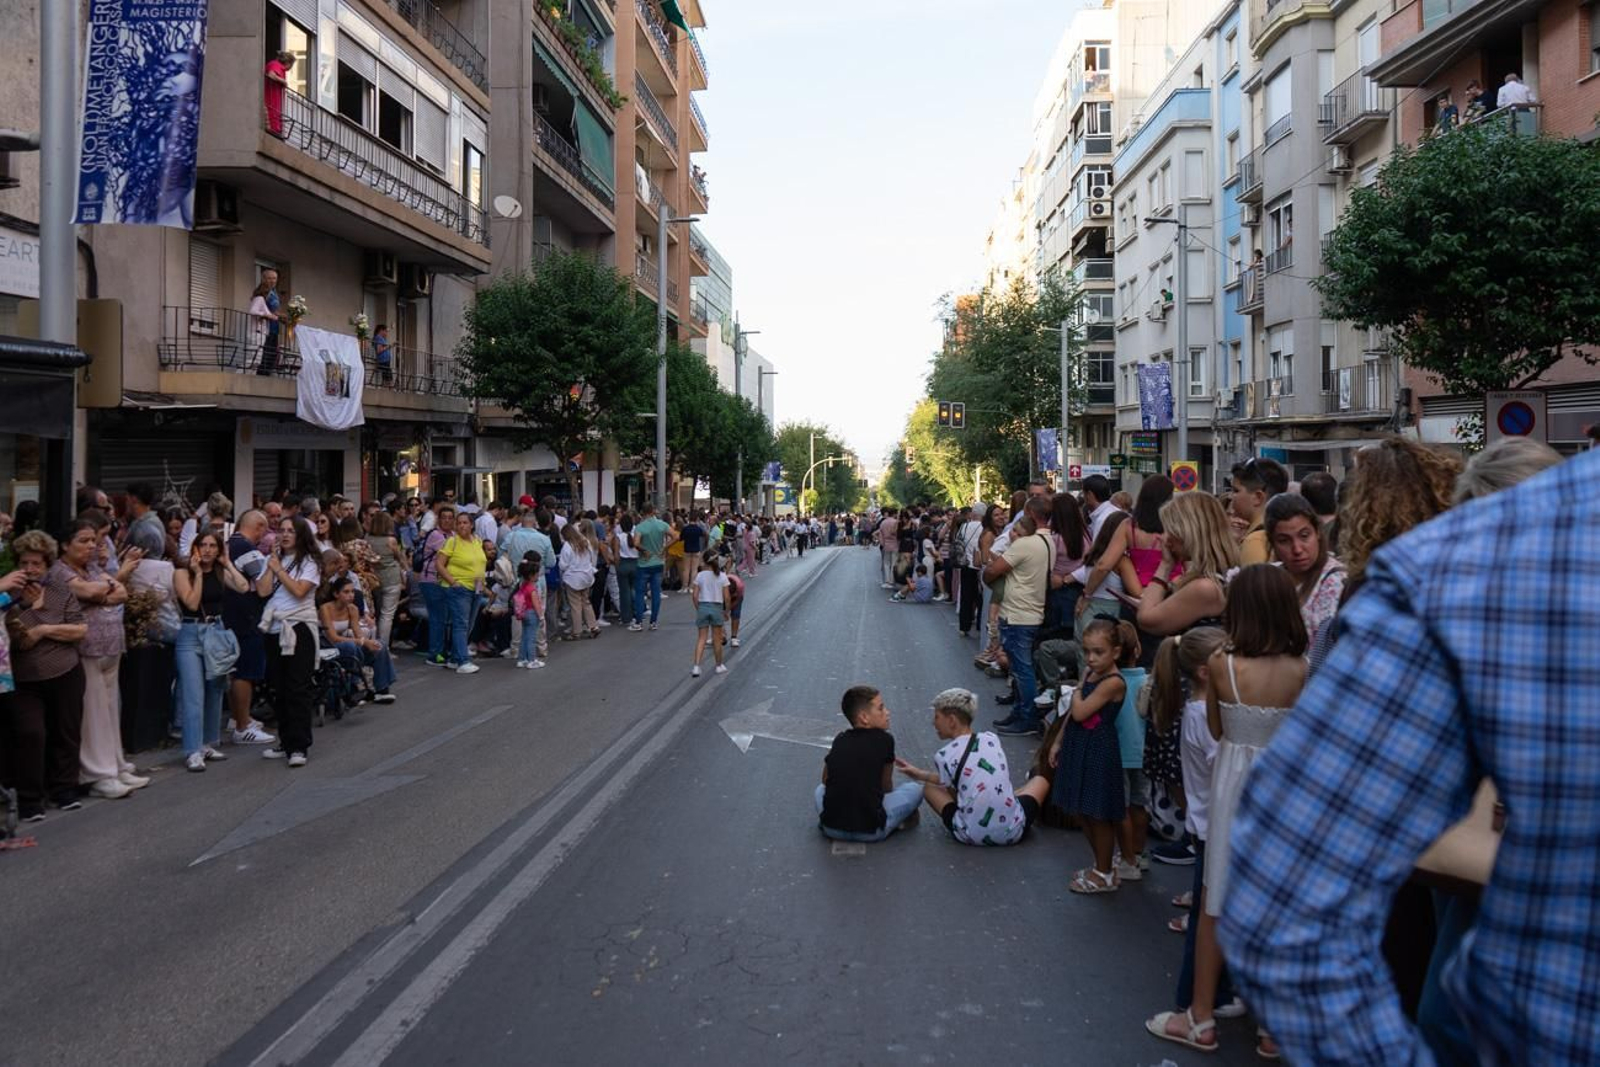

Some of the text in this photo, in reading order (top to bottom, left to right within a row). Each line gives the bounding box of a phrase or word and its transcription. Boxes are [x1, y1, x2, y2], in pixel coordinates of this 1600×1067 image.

[129, 7, 207, 18] MAGISTERIO
[81, 0, 111, 173] (NOLI)METANGER
[98, 43, 118, 132] FRANCISCO
[96, 136, 110, 172] JUAN
